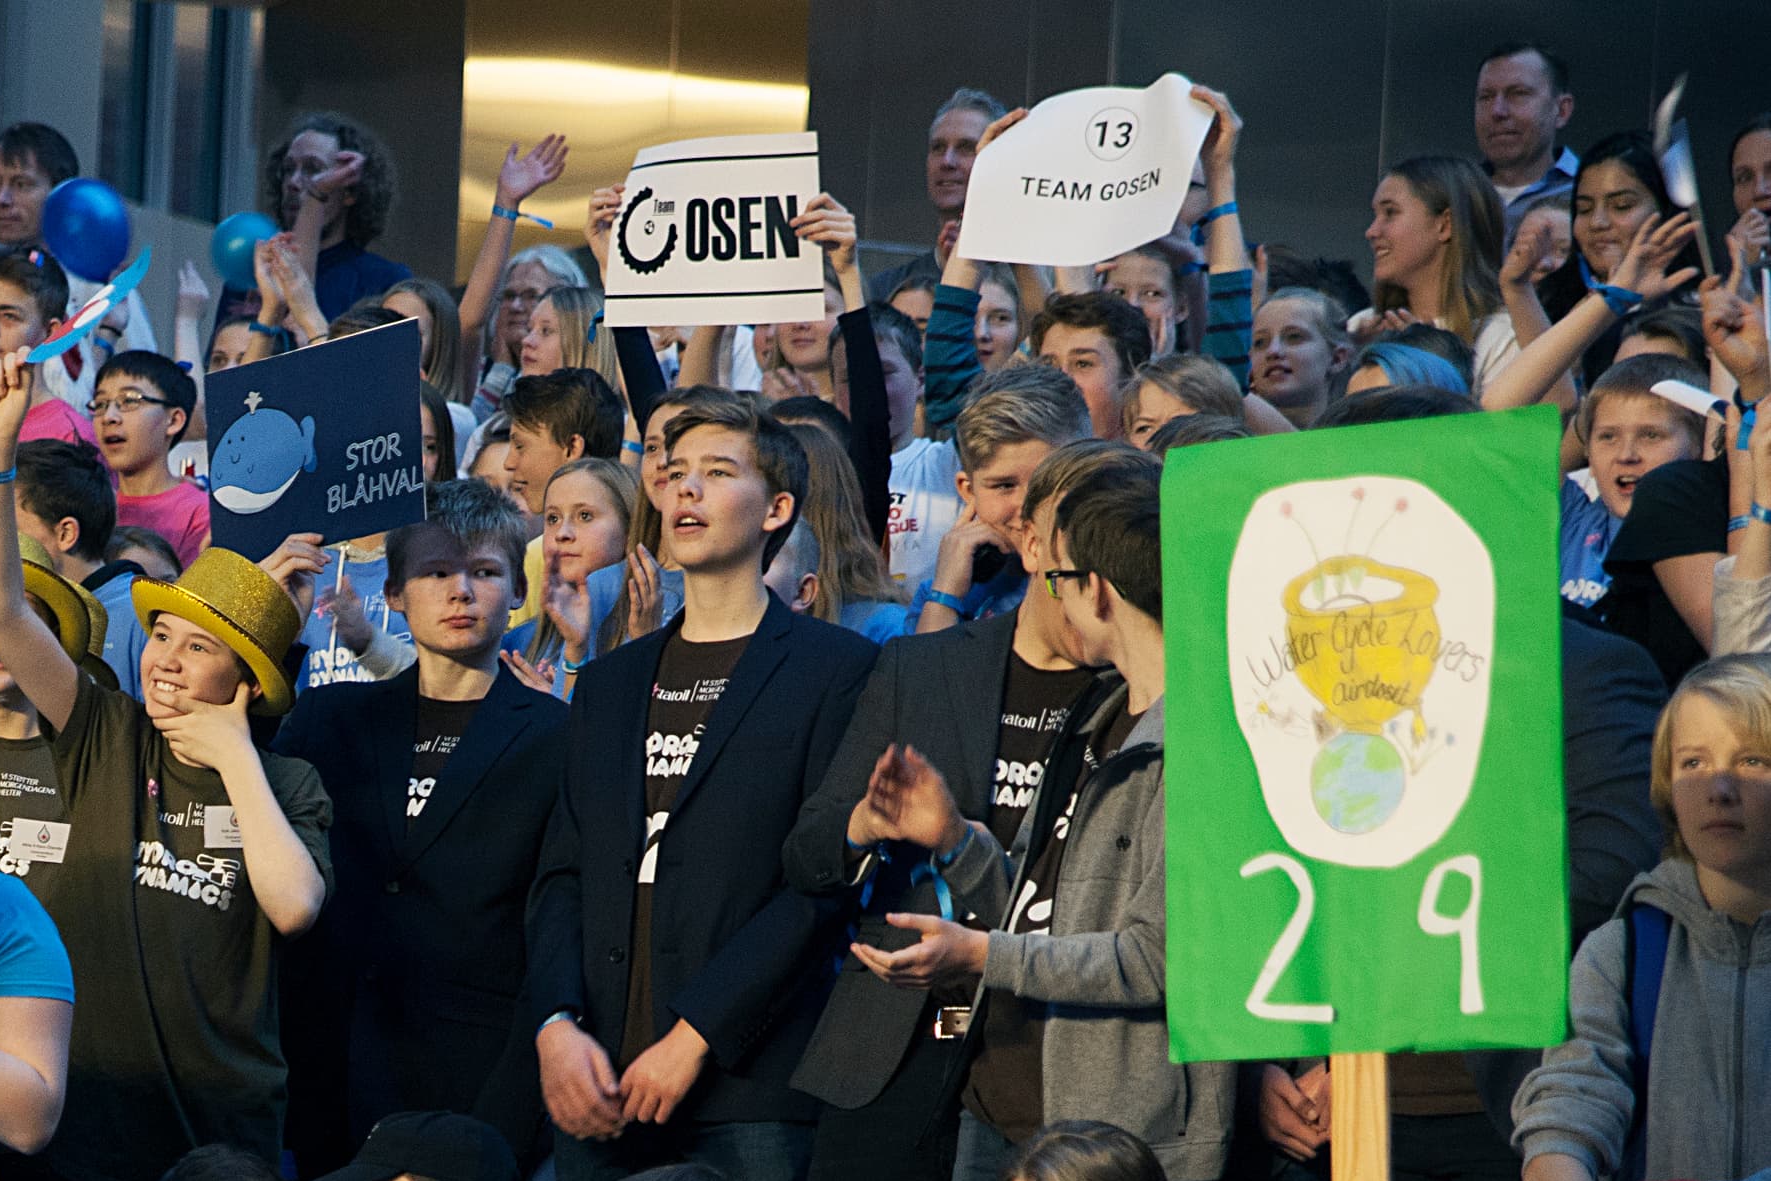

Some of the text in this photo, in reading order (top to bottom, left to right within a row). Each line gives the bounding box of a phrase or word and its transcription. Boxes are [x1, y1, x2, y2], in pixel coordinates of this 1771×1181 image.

[1094, 120, 1133, 148] 13
[1021, 168, 1160, 201] TEAM GOSEN
[654, 199, 675, 213] Team
[346, 432, 402, 471] STOR
[327, 465, 424, 513] BLÅHVAL
[1245, 626, 1323, 688] Water
[1331, 607, 1390, 675] Cycle
